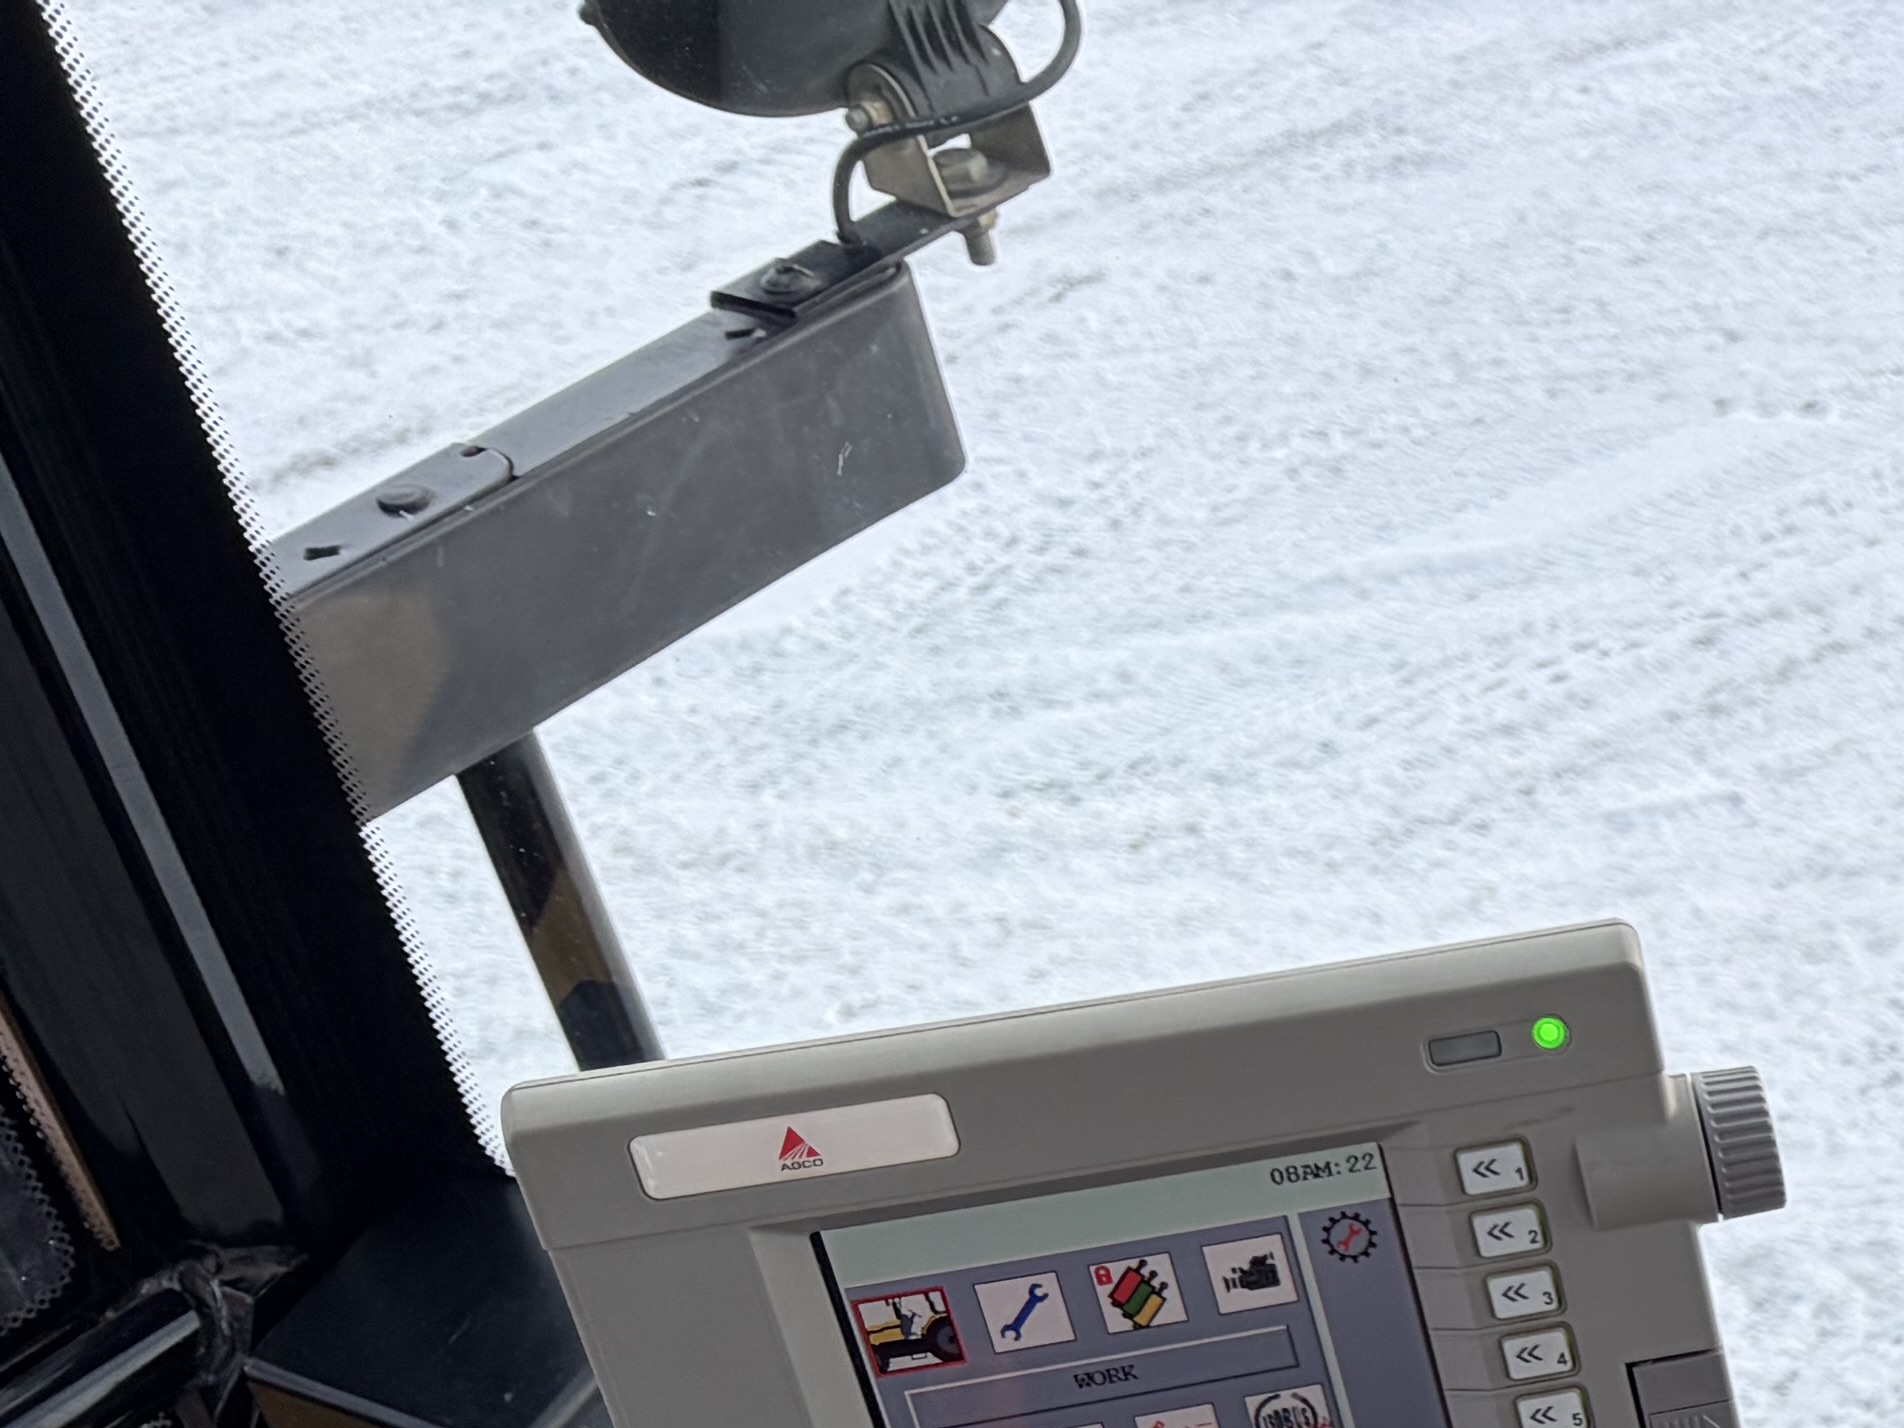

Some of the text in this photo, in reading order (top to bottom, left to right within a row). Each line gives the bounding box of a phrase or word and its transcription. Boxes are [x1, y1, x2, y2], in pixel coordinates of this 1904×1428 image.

[780, 1158, 824, 1172] AGCO
[1515, 1166, 1525, 1181] 1
[1528, 1229, 1540, 1244] 2
[1542, 1291, 1554, 1305] 3
[1556, 1352, 1568, 1367] 4
[1073, 1364, 1139, 1389] WORK
[1572, 1412, 1583, 1427] 5
